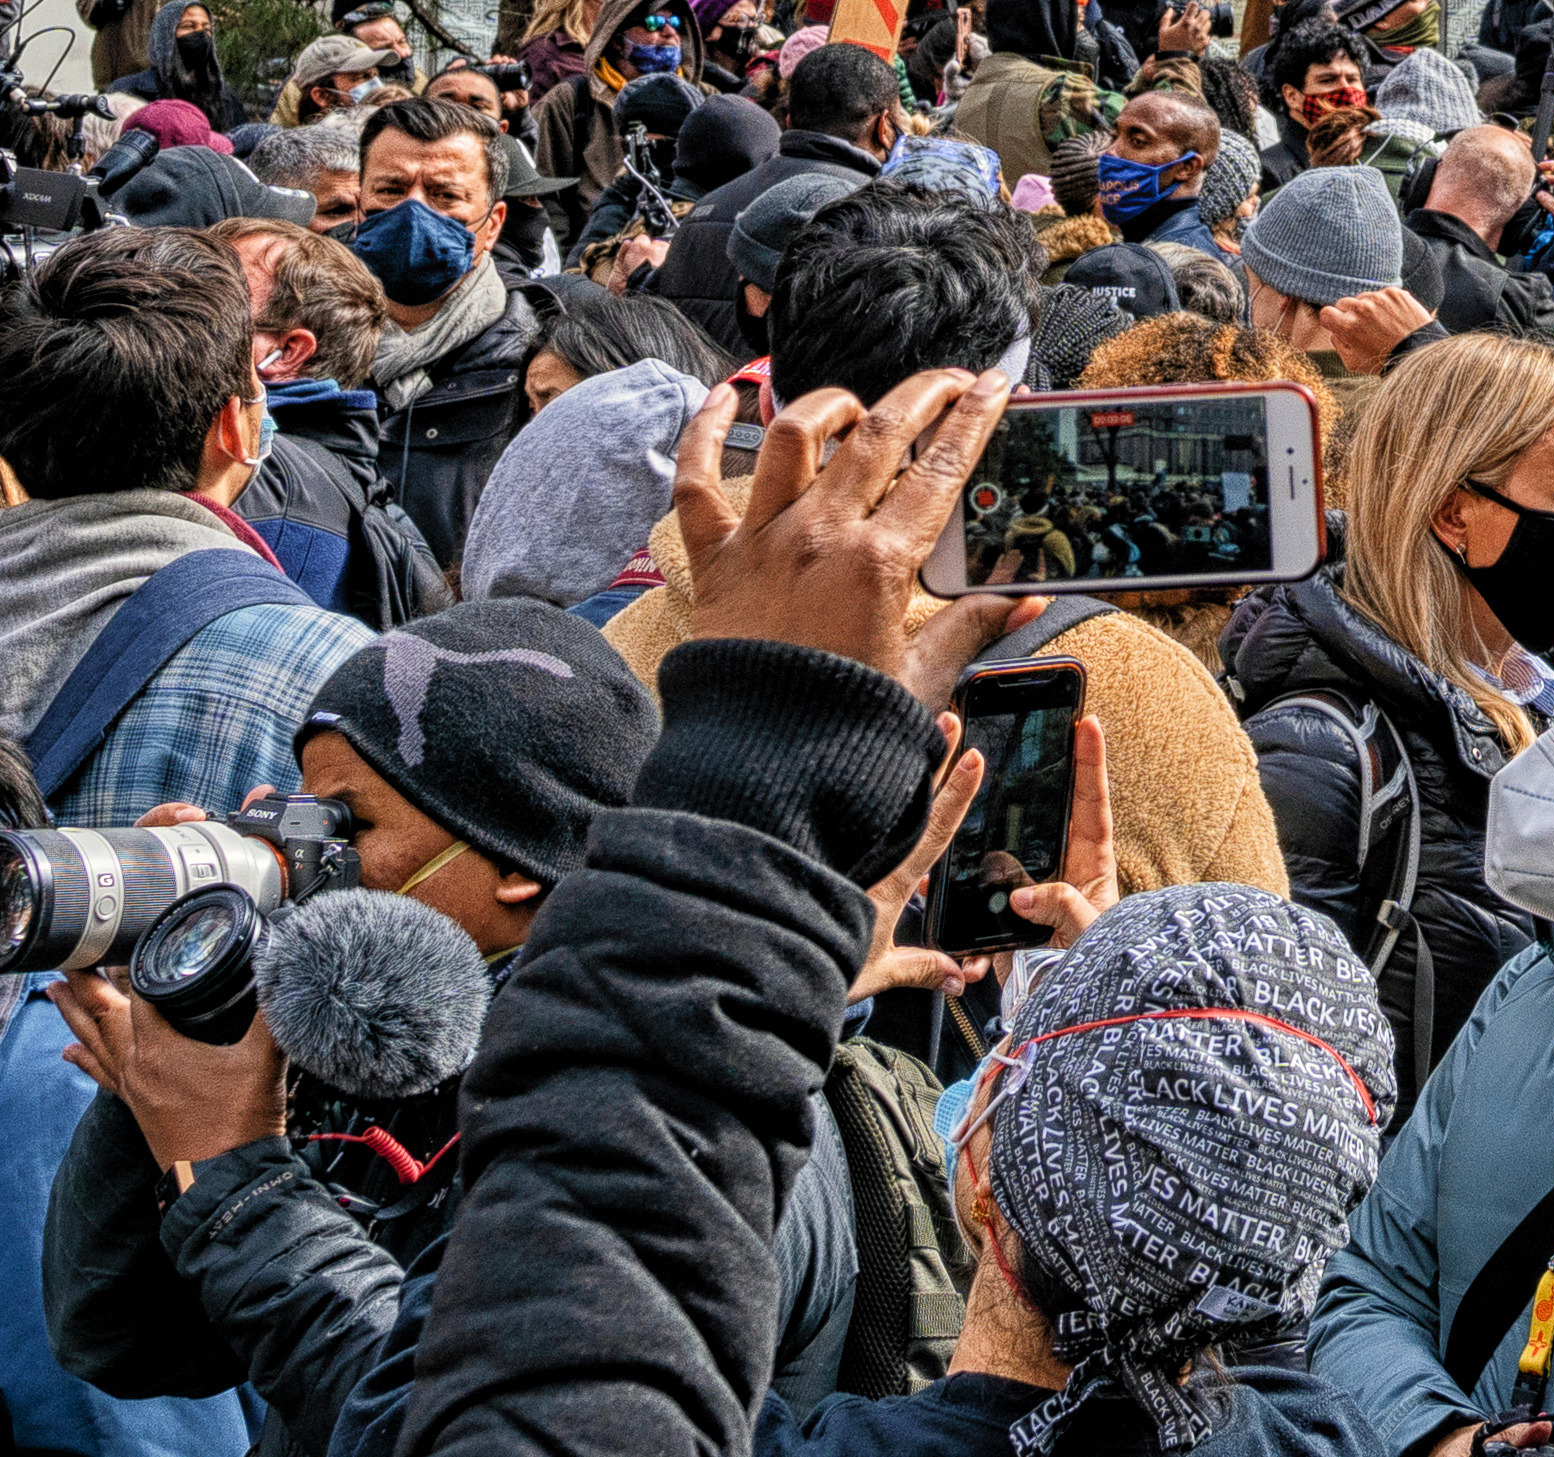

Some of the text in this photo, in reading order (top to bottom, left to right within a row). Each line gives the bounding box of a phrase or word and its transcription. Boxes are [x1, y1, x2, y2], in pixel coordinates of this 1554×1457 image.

[1093, 285, 1136, 299] JUSTICE
[246, 808, 279, 820] SONY
[1231, 959, 1278, 979] BLACK
[1280, 970, 1318, 991] LIVES
[1254, 980, 1376, 1036] BLACK VES
[1232, 1064, 1278, 1081] BLACK
[1280, 1073, 1321, 1092] LIVES
[1080, 1027, 1128, 1197] BLAC LIVES
[1195, 1109, 1236, 1130] BLACK
[1238, 1121, 1281, 1144] LIVES
[1283, 1133, 1334, 1163] MATTER
[1213, 1083, 1299, 1127] LIVES
[1302, 1108, 1365, 1164] MATTER
[1019, 1104, 1049, 1202] MATTER
[1043, 1126, 1070, 1208] LIVES
[1126, 1143, 1147, 1190] BLACK
[1181, 1130, 1240, 1163] MATTER
[1246, 1154, 1291, 1182] BLACK
[1292, 1170, 1328, 1193] LIVES
[1187, 1162, 1229, 1189] LIVES
[1230, 1179, 1288, 1209] MATTER
[1178, 1189, 1286, 1253] MATTER
[1179, 1230, 1224, 1264] BLACK
[1226, 1253, 1265, 1278] LIVES
[1141, 1372, 1170, 1418] BLACK
